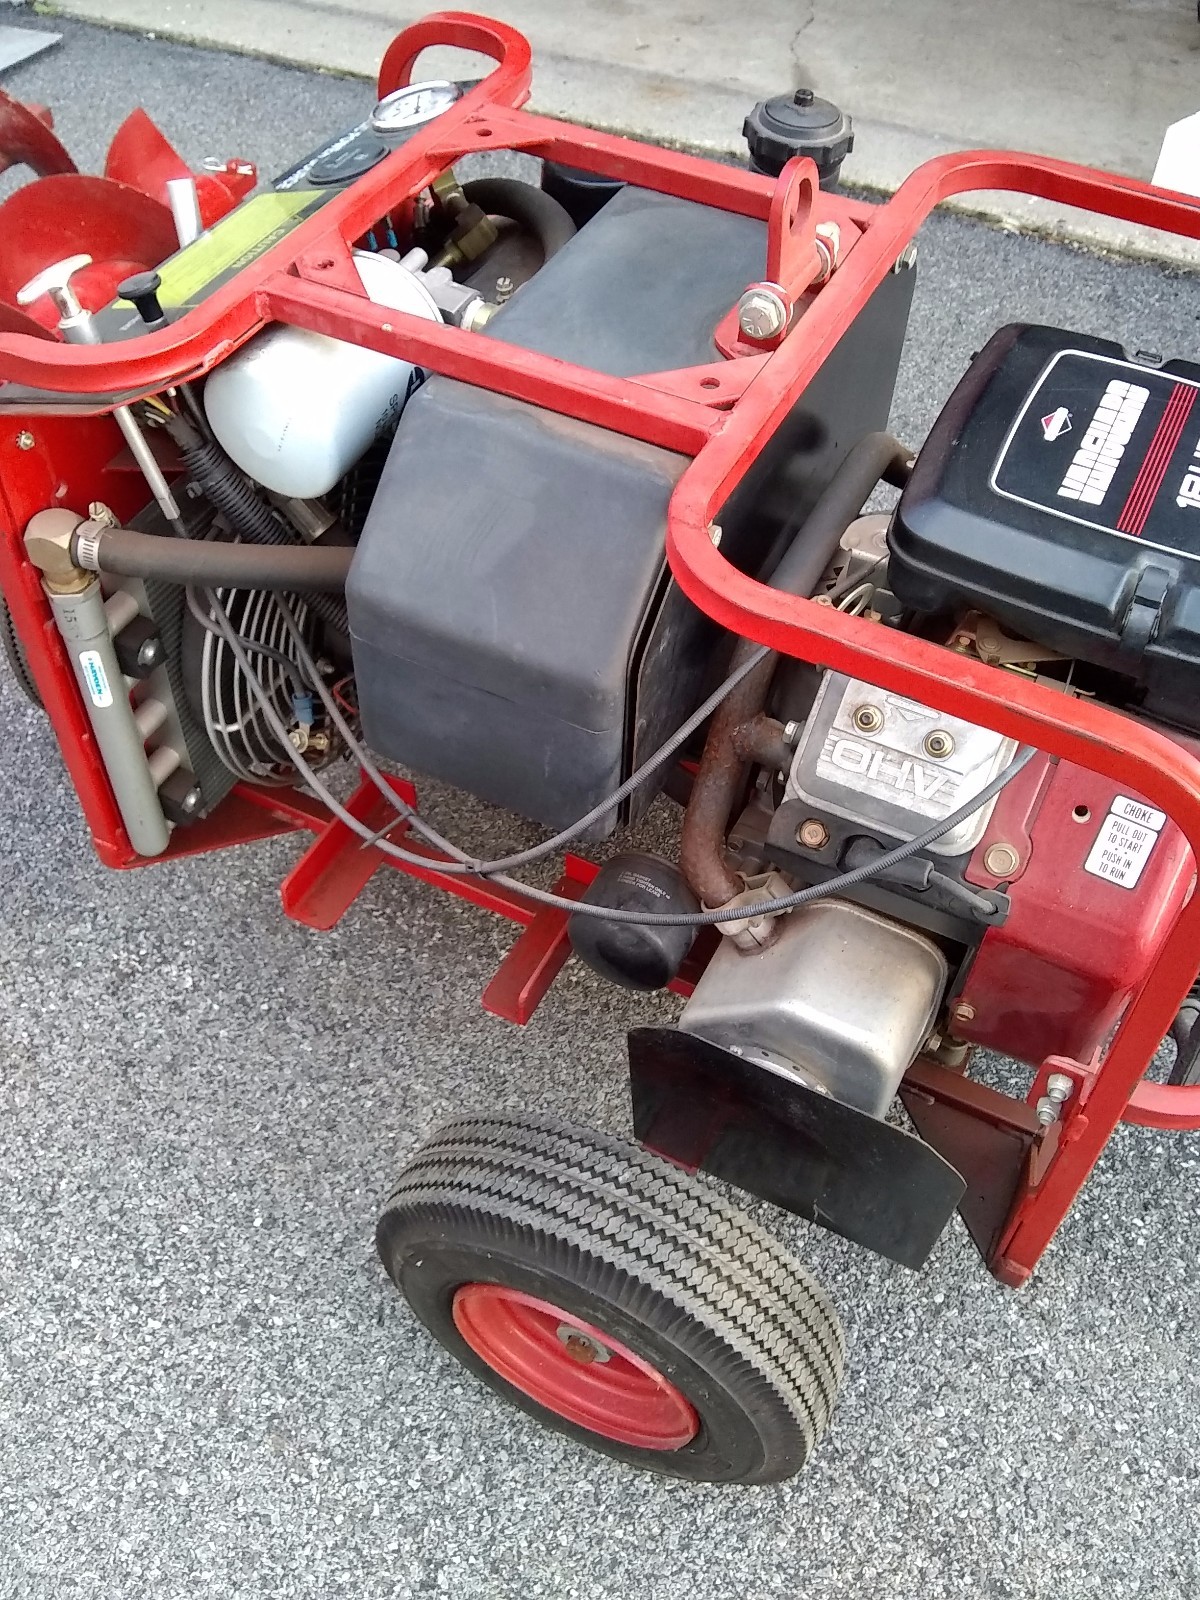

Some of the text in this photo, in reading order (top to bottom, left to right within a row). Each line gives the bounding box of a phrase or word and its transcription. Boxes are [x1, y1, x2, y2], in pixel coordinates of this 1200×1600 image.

[1057, 379, 1150, 506] VANGUARD
[88, 662, 104, 695] HAYDEN
[831, 739, 950, 800] OHV
[1123, 803, 1154, 824] CHOKE
[1111, 820, 1149, 843] PULL OUT
[1107, 832, 1143, 854] TO START
[1101, 849, 1133, 870] PUSH IN
[1098, 861, 1127, 881] TO RUN
